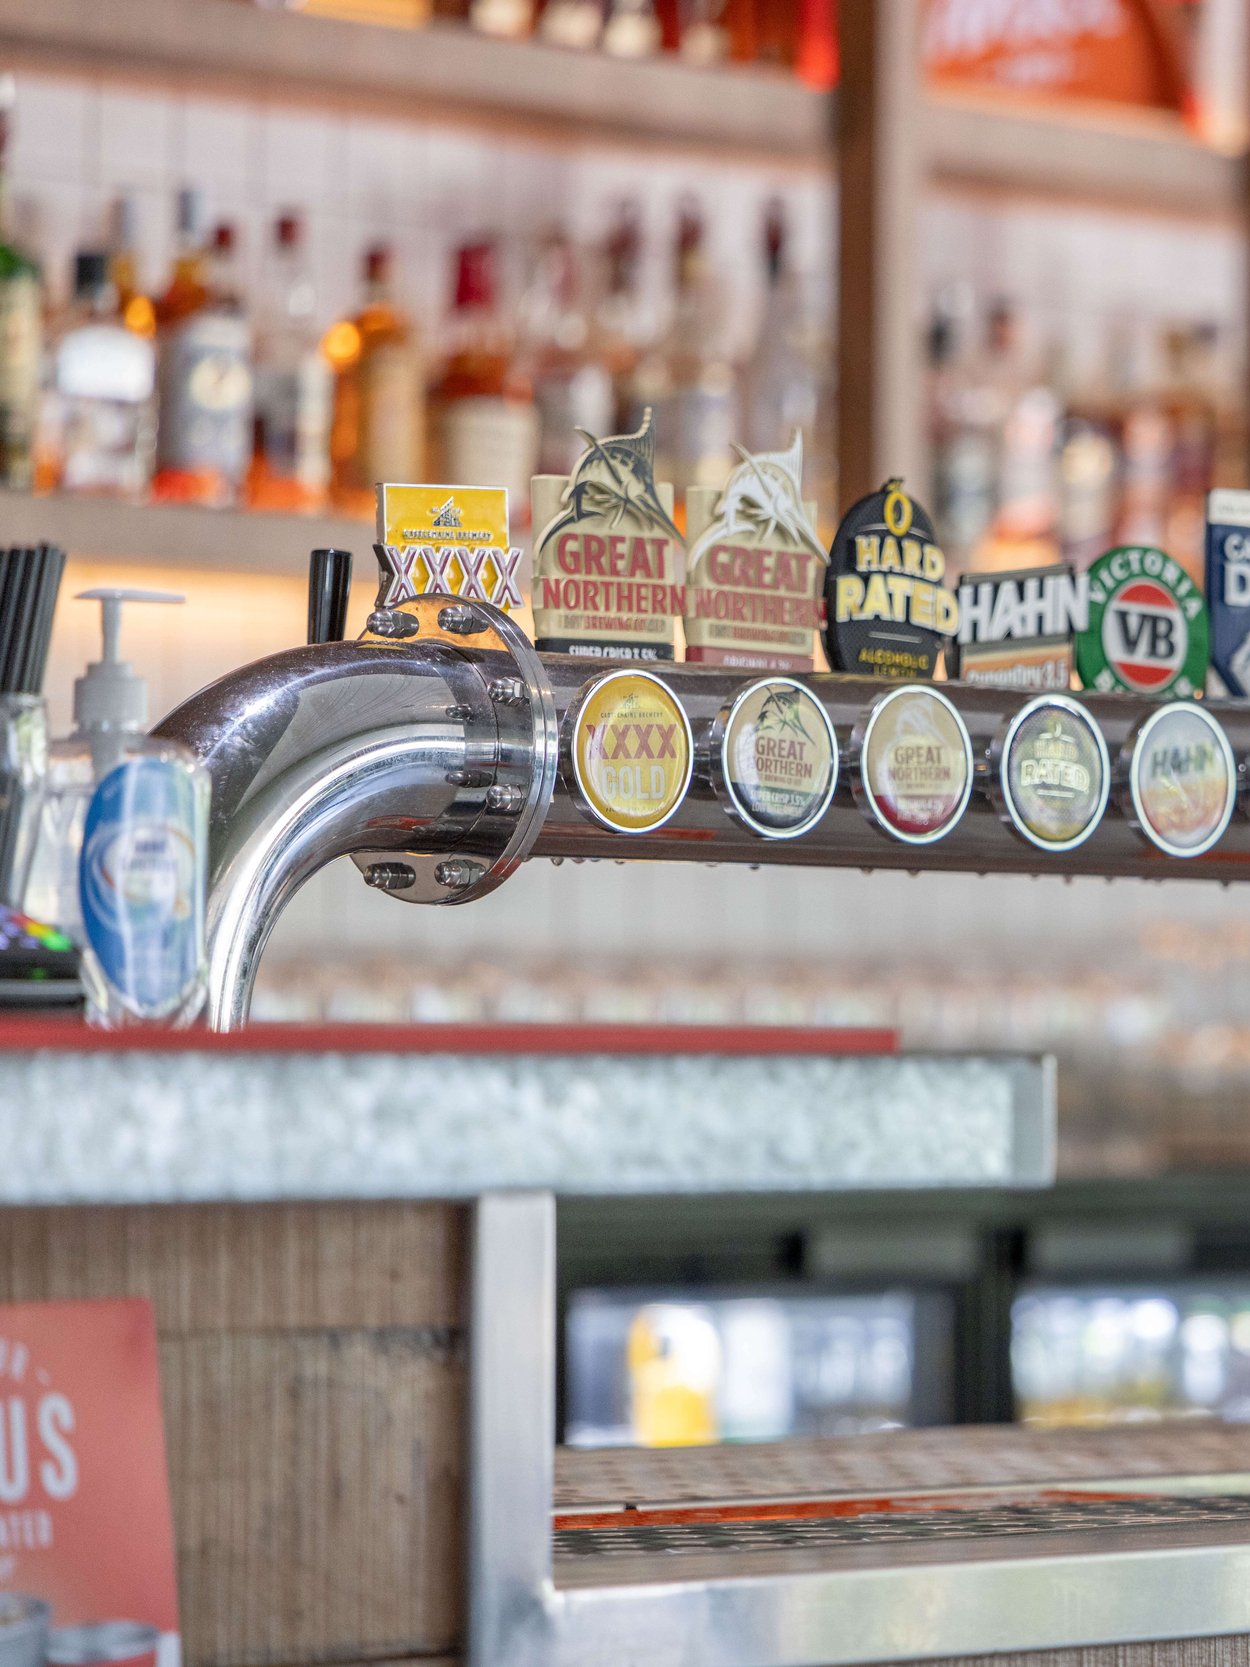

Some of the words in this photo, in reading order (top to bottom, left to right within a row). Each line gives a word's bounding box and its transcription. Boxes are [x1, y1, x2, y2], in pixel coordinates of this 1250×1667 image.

[382, 545, 525, 609] XXXX
[557, 532, 669, 580] GREAT
[708, 544, 812, 593] GREAT
[854, 535, 946, 582] HARD
[542, 577, 688, 617] NORTHERN
[836, 573, 962, 637] RATED
[1088, 549, 1203, 621] VICTORIA
[694, 588, 828, 631] NORTHERN
[957, 572, 1090, 645] HAHN
[1114, 610, 1176, 660] VB
[586, 724, 678, 760] XXXX
[755, 736, 807, 761] GREAT
[894, 746, 942, 765] GREAT
[601, 765, 666, 801] GOLD
[754, 755, 813, 779] ORTHERN
[888, 766, 951, 782] NORTHERN
[1020, 758, 1091, 794] RATED
